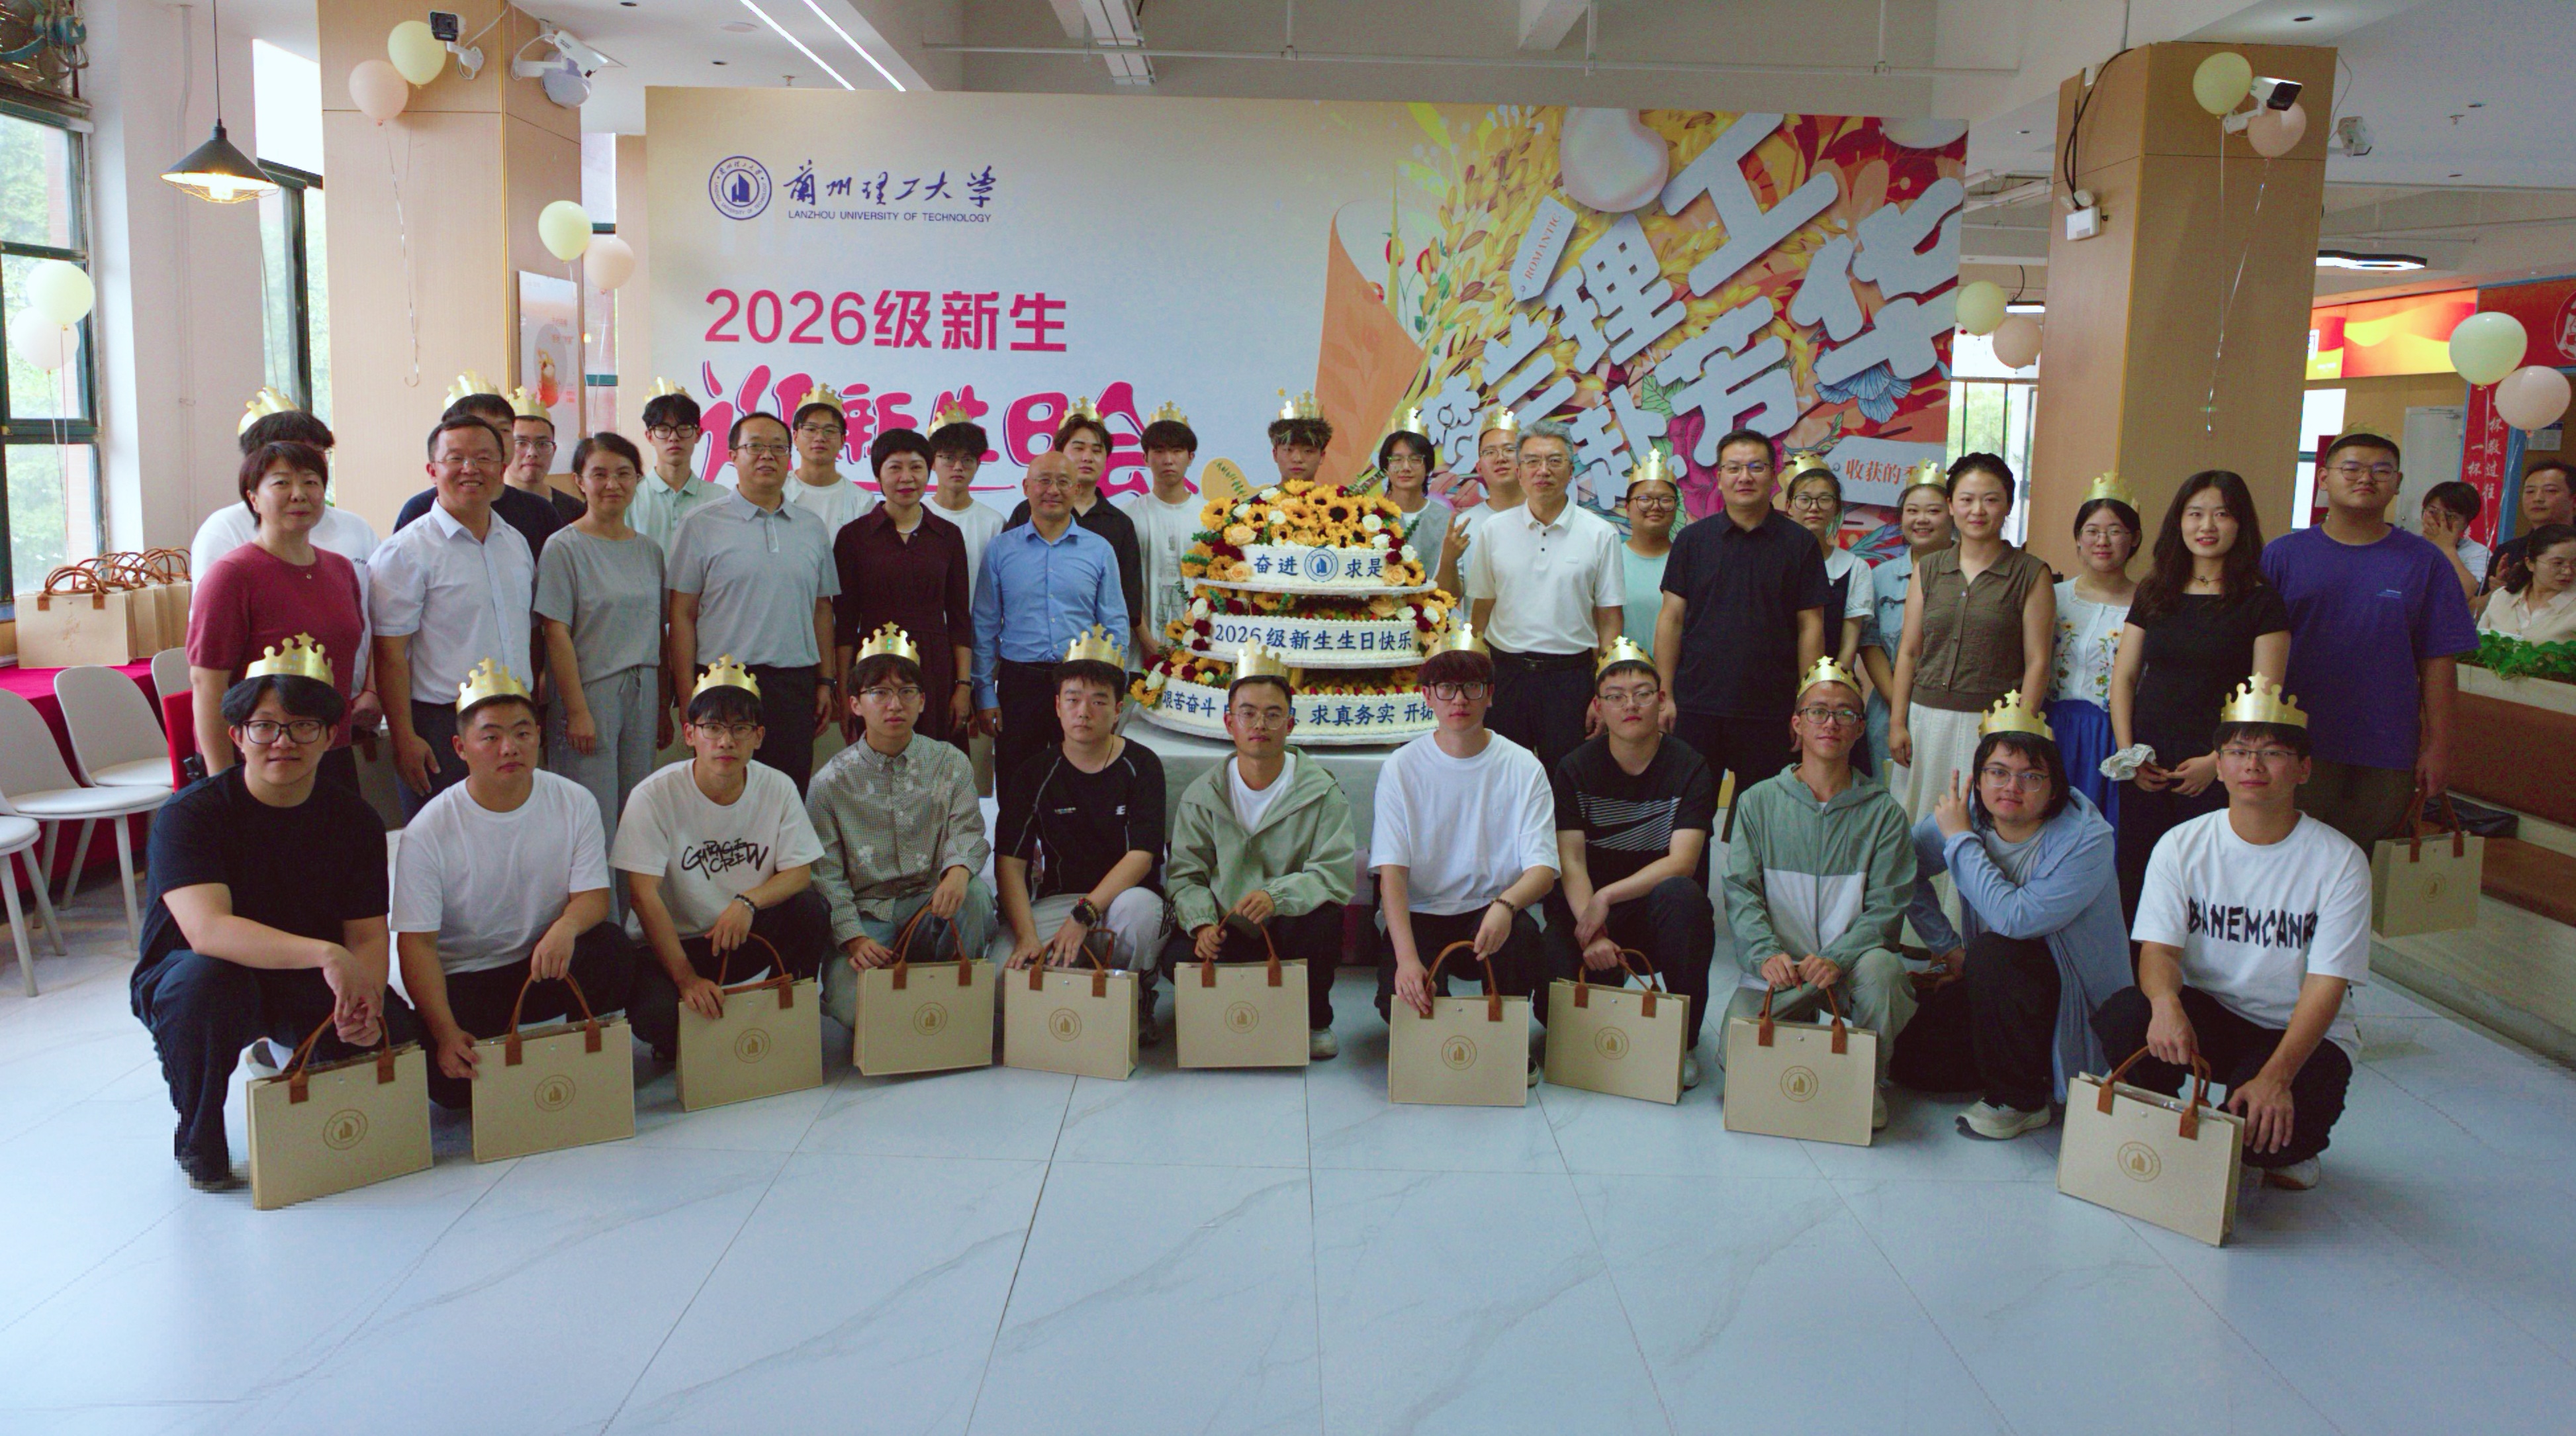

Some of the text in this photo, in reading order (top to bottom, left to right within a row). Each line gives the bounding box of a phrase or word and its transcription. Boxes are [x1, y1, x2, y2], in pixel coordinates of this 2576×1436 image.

[788, 210, 835, 219] LANZHOU
[840, 211, 899, 220] UNIVERSITY
[922, 213, 991, 222] TECHNOLOGY
[1524, 213, 1561, 279] ROMANTIC
[704, 289, 1067, 352] 2026级新生
[2483, 403, 2504, 499] 杯敬过往
[1254, 553, 1298, 576] 奋进
[1345, 557, 1383, 579] 求是
[1162, 690, 1217, 718] 艰苦奋斗
[1309, 702, 1395, 726] 求真务实
